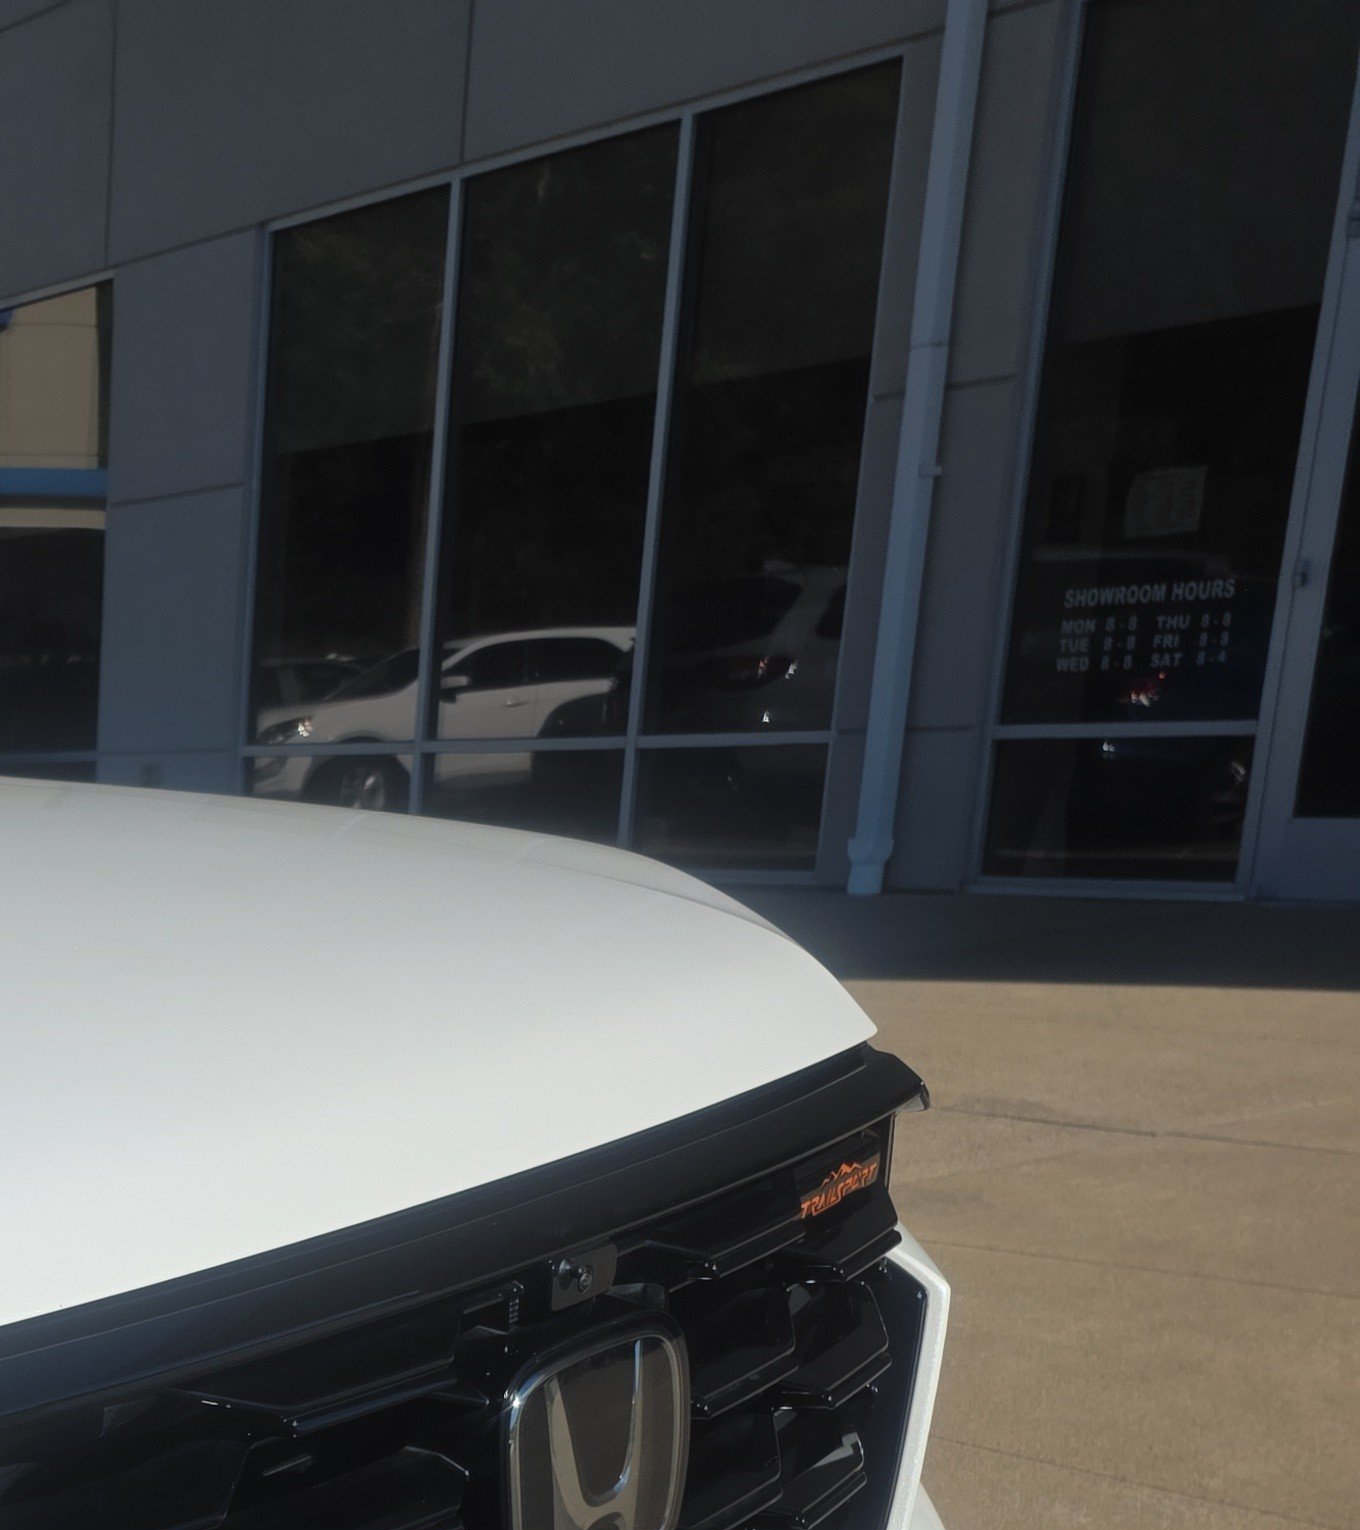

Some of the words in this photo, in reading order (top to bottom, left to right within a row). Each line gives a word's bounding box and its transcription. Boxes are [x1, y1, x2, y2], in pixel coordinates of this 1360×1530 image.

[1063, 583, 1166, 608] SHOWROOM
[1171, 577, 1236, 602] HOURS
[1061, 618, 1097, 634] MON
[1156, 614, 1191, 630] THU
[1059, 637, 1089, 654] TUE
[1153, 633, 1180, 648] FRI
[1056, 656, 1090, 671] WED
[1150, 652, 1183, 668] SAT
